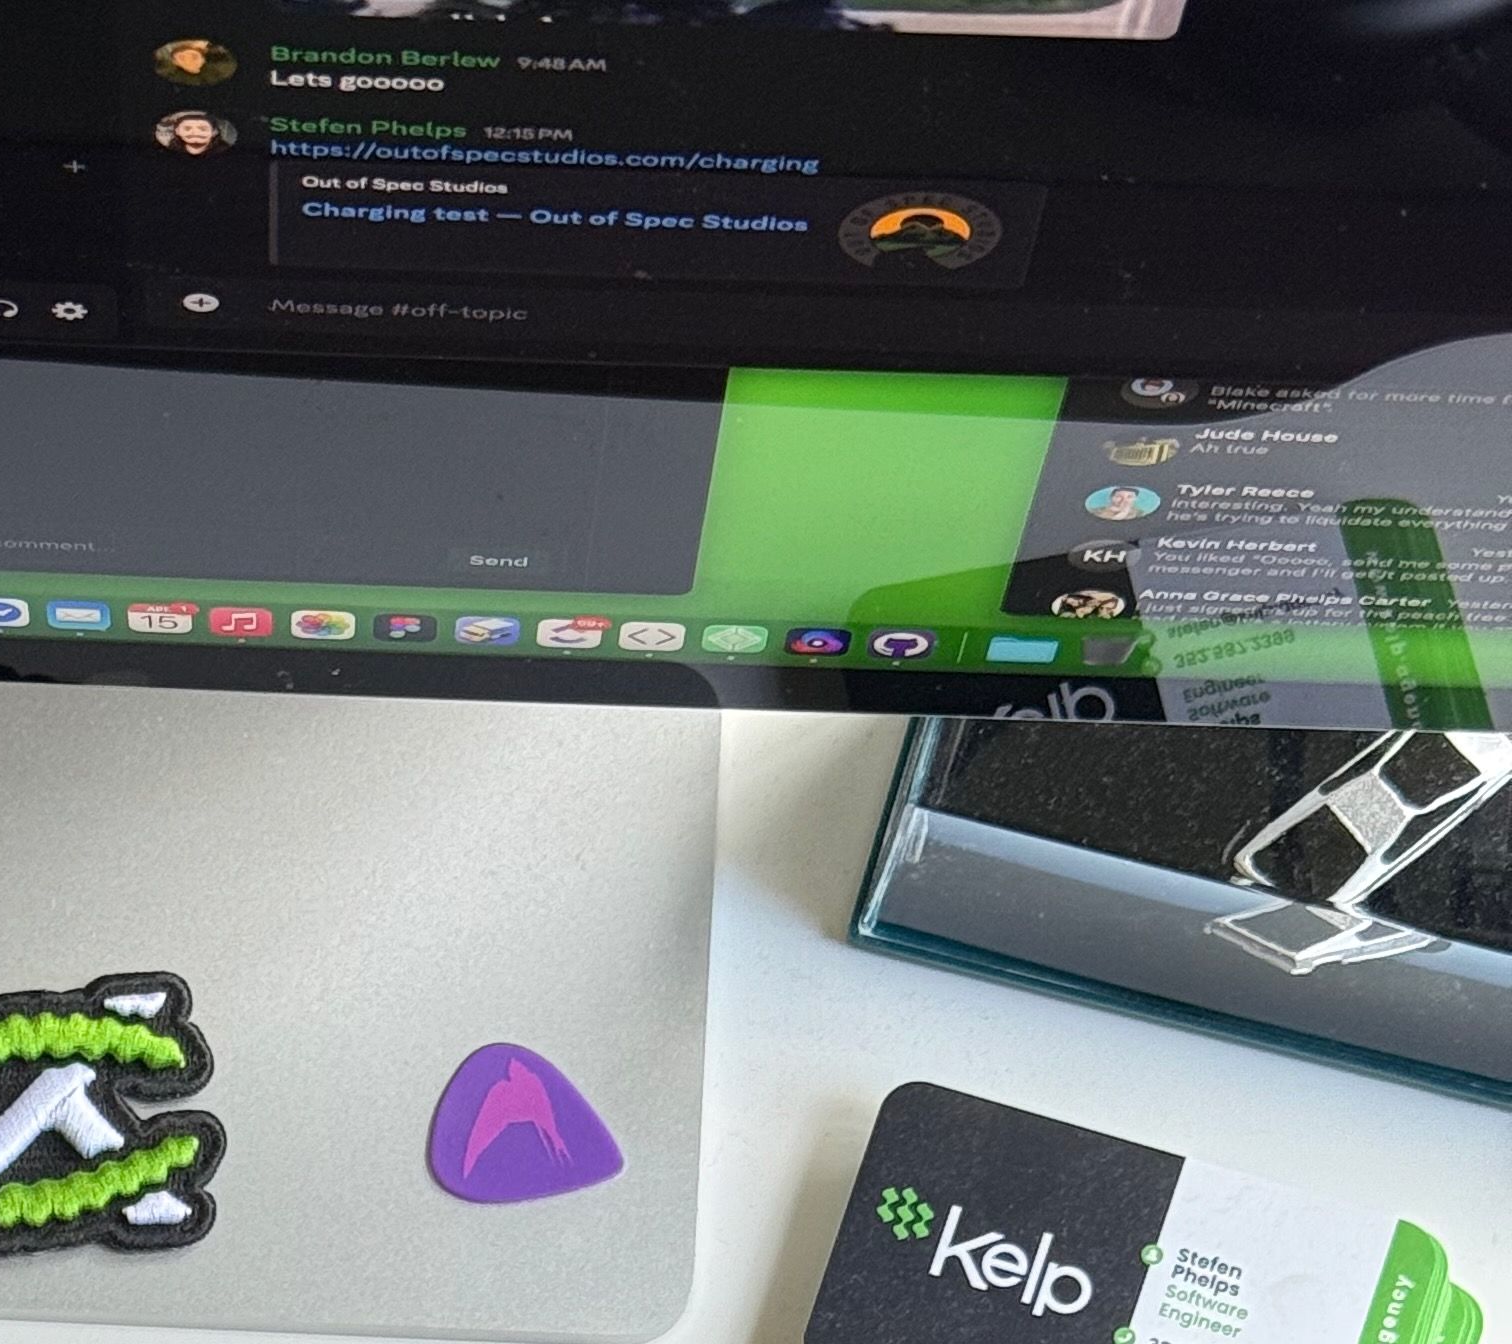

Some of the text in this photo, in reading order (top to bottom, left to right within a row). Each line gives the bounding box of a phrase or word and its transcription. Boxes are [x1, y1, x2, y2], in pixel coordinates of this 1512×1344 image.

[270, 44, 393, 66] Brandon
[400, 48, 500, 69] Berlew
[270, 70, 445, 94] Lets gooooo
[269, 117, 363, 136] Stefen
[371, 119, 468, 140] Phelps
[270, 140, 820, 174] https://outofspecstudios.com/charging
[302, 175, 508, 196] Out of Spec Studios
[302, 201, 426, 224] Charging
[434, 205, 489, 222] test
[529, 208, 583, 226] Out
[588, 210, 618, 227] of
[626, 212, 694, 233] Spec
[703, 214, 809, 233] Studios
[270, 298, 529, 323] Message #off-topic
[1210, 385, 1496, 405] Blake asked for more time
[1194, 428, 1338, 444] Jude House
[1189, 443, 1269, 456] Ah true
[1176, 484, 1316, 499] Tyler Reece
[1296, 502, 1347, 513] Yeah
[1352, 505, 1386, 517] my
[1214, 512, 1275, 526] trying
[1278, 513, 1300, 525] to
[1304, 514, 1393, 529] liquidate
[1397, 518, 1509, 533] everything
[1156, 536, 1221, 551] Kevin
[1226, 539, 1318, 553] Herbert
[469, 553, 528, 569] Send
[1081, 549, 1128, 564] KH
[1153, 551, 1191, 563] You
[1196, 552, 1246, 564] liked
[1397, 560, 1431, 569] me
[1435, 561, 1494, 572] some
[1147, 564, 1262, 578] messenger
[1266, 566, 1307, 578] and
[1399, 571, 1474, 583] posted
[1138, 588, 1198, 602] Anna
[1202, 590, 1270, 603] Grace
[1275, 592, 1354, 606] Phelps
[1358, 595, 1433, 608] Carter
[1144, 603, 1183, 615] just
[1291, 606, 1320, 618] up
[1324, 607, 1353, 618] for
[140, 614, 178, 630] 15
[1175, 1247, 1244, 1280] Stefen
[1170, 1265, 1241, 1298] Phelps
[1165, 1283, 1250, 1322] Software
[1157, 1303, 1242, 1340] Engineer
